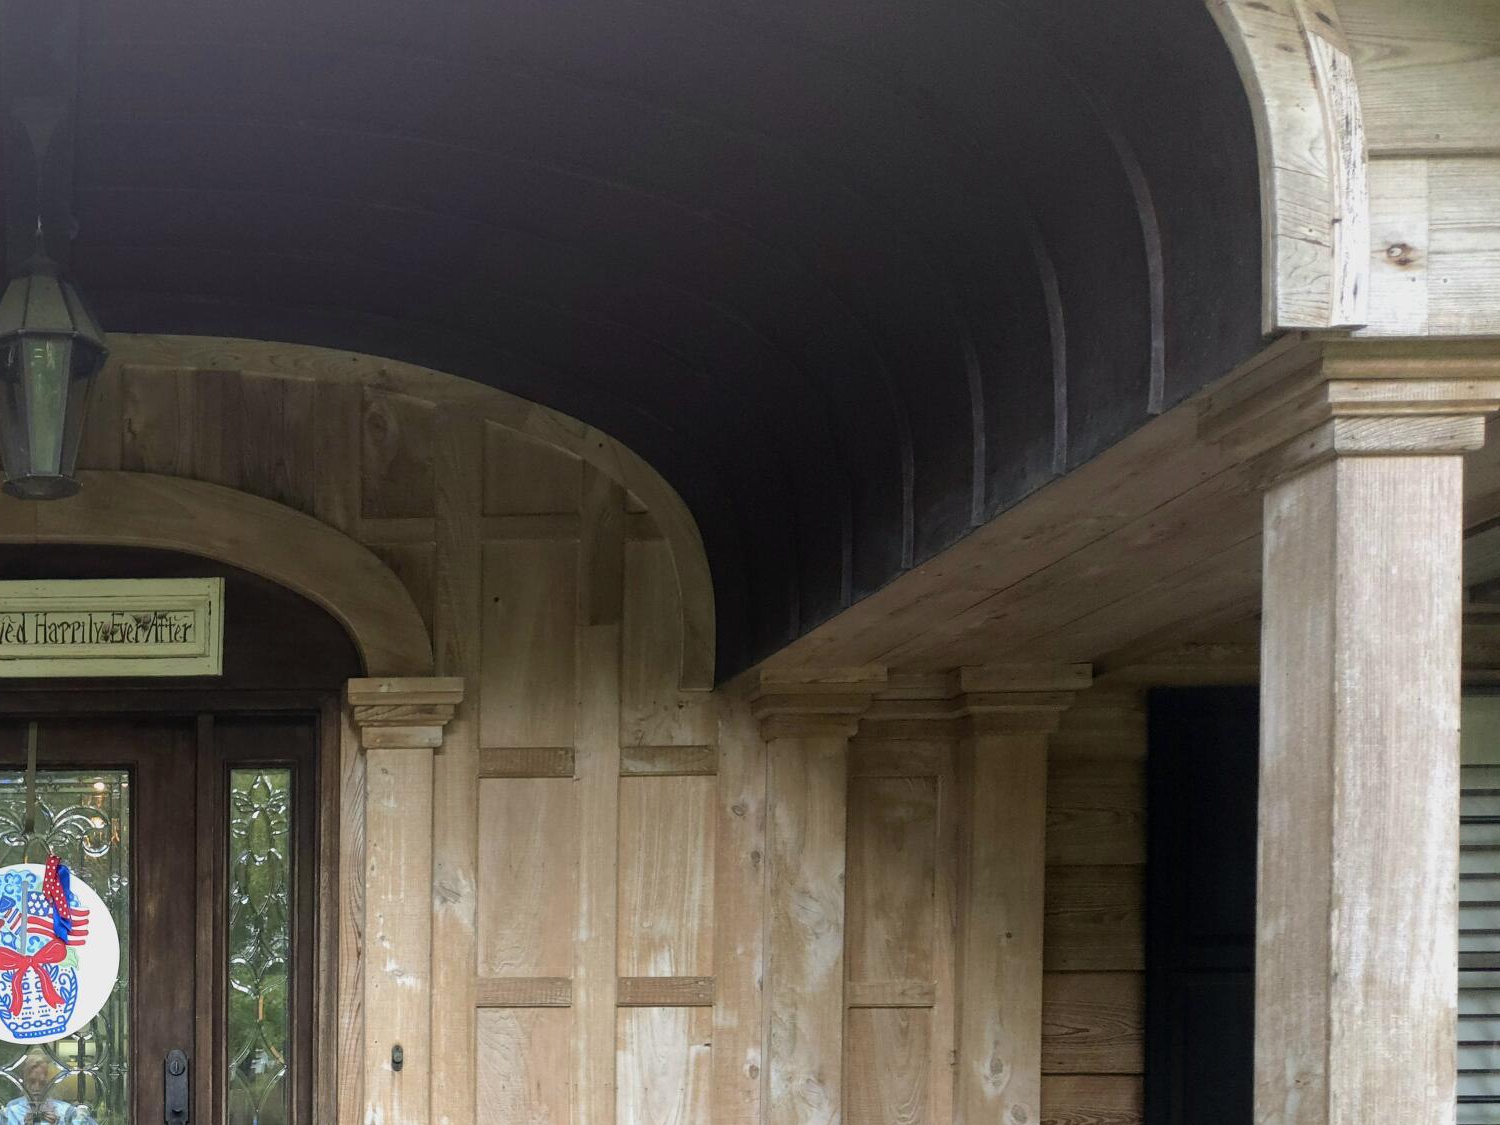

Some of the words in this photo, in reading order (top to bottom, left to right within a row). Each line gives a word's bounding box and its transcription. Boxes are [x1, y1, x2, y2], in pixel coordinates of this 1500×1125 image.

[35, 612, 104, 644] Happily
[109, 611, 143, 644] Ever
[145, 611, 192, 643] After
